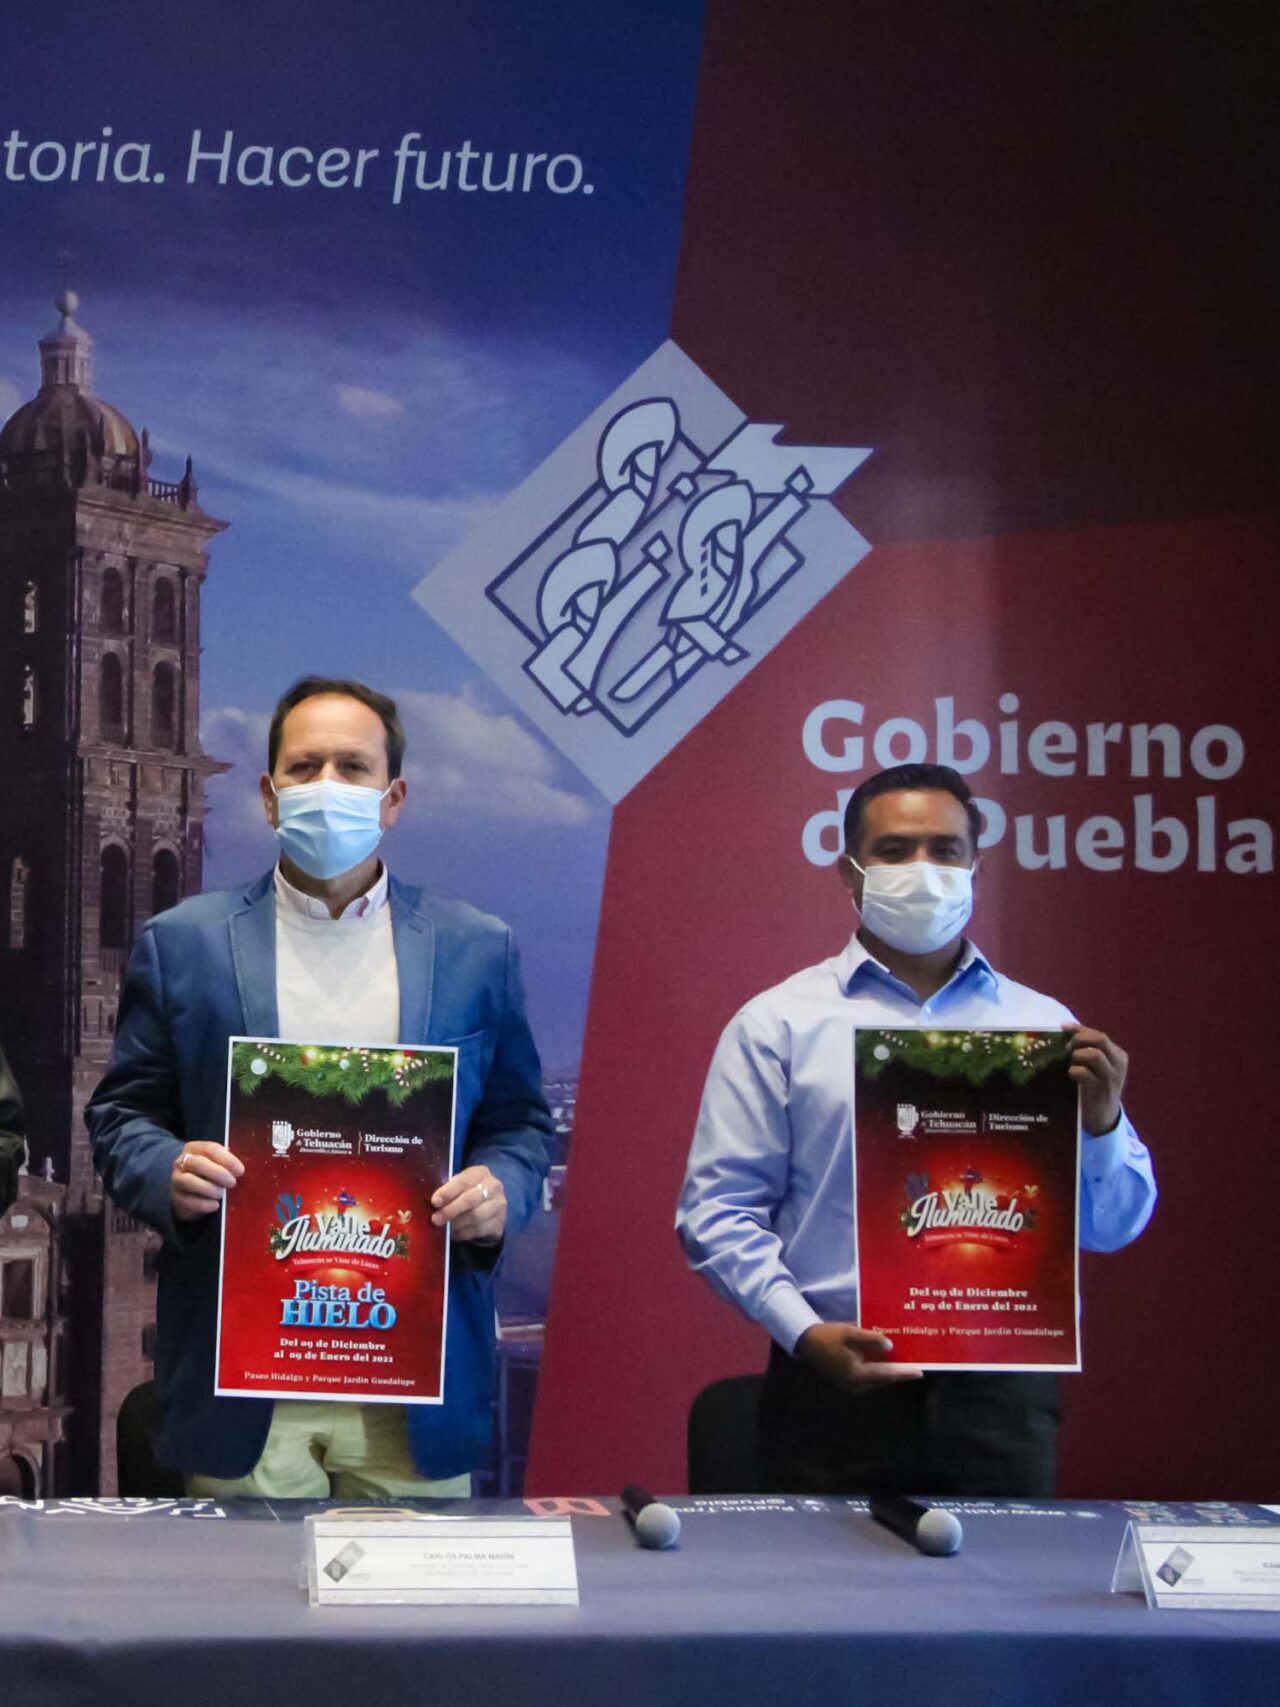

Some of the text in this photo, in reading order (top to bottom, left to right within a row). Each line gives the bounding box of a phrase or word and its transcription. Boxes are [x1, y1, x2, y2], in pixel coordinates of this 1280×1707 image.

[187, 130, 379, 188] Hacer
[393, 132, 596, 204] futuro.
[802, 693, 1245, 780] Gobierno
[1036, 1114, 1048, 1122] de
[989, 1122, 1028, 1130] Turismo
[296, 1128, 341, 1139] Gobierno
[364, 1134, 423, 1145] Dirección de
[304, 1138, 352, 1150] Tehuacán
[364, 1144, 404, 1153] Turismo
[942, 1190, 998, 1212] Valle
[907, 1192, 1024, 1236] Iluminado
[315, 1212, 370, 1236] Valle
[276, 1215, 395, 1260] Iluminado
[294, 1279, 385, 1303] Pista de
[910, 1287, 1028, 1299] Del 09 de Diciembre
[904, 1301, 1037, 1312] al 09 de Enero del 2022
[280, 1299, 396, 1330] HIELO
[280, 1338, 386, 1350] Del 09 de Diciembre
[274, 1350, 284, 1359] al
[289, 1352, 302, 1361] 09
[305, 1351, 317, 1360] de
[320, 1352, 351, 1361] Enero
[353, 1353, 369, 1362] del
[244, 1372, 269, 1380] Paseo
[271, 1372, 304, 1382] Hidalgo
[312, 1375, 342, 1384] Parque
[371, 1377, 416, 1387] Guadalupe
